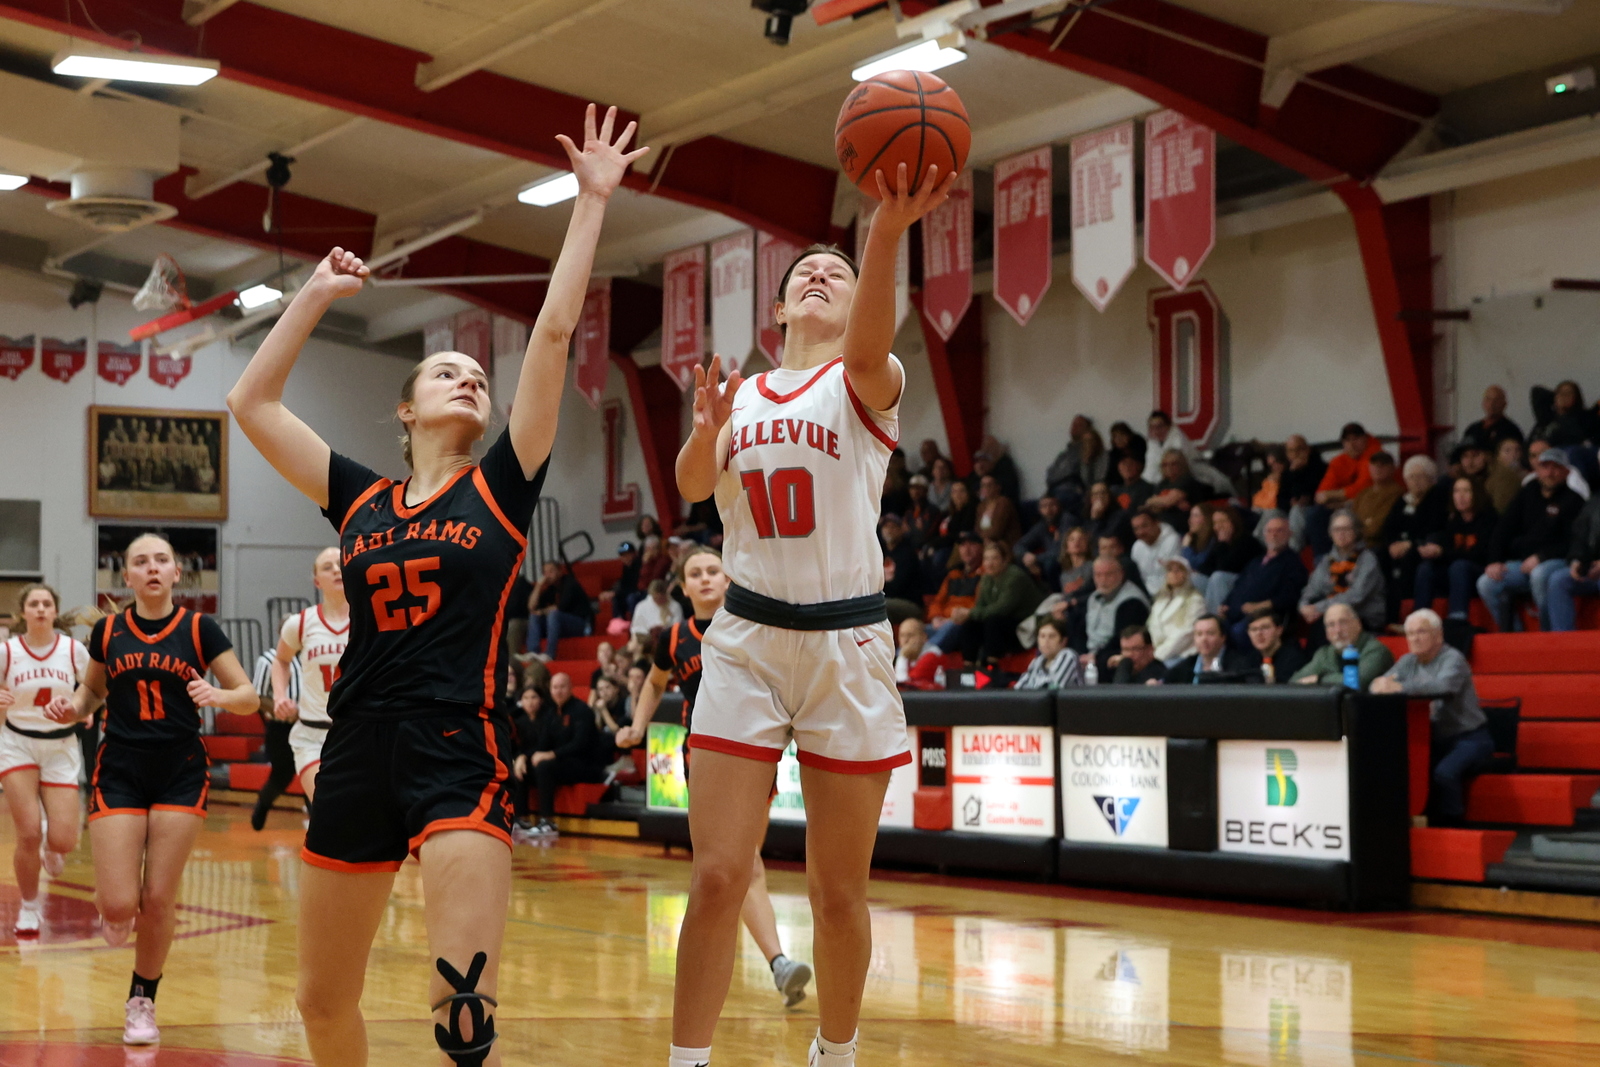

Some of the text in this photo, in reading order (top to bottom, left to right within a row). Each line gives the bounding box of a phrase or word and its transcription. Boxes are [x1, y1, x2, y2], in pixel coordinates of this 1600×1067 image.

[1147, 280, 1222, 449] D
[730, 418, 841, 461] ELLEVUE
[601, 398, 641, 522] L
[740, 467, 816, 540] 10
[403, 519, 483, 550] RAMS
[365, 556, 441, 632] 25
[107, 652, 195, 680] LADY RAMS
[307, 643, 347, 661] BELLE
[33, 687, 52, 706] 4
[136, 679, 165, 720] 11
[962, 735, 1041, 753] LAUGHLIN
[1071, 744, 1160, 769] CROGHAN
[1225, 820, 1342, 850] BECK'S
